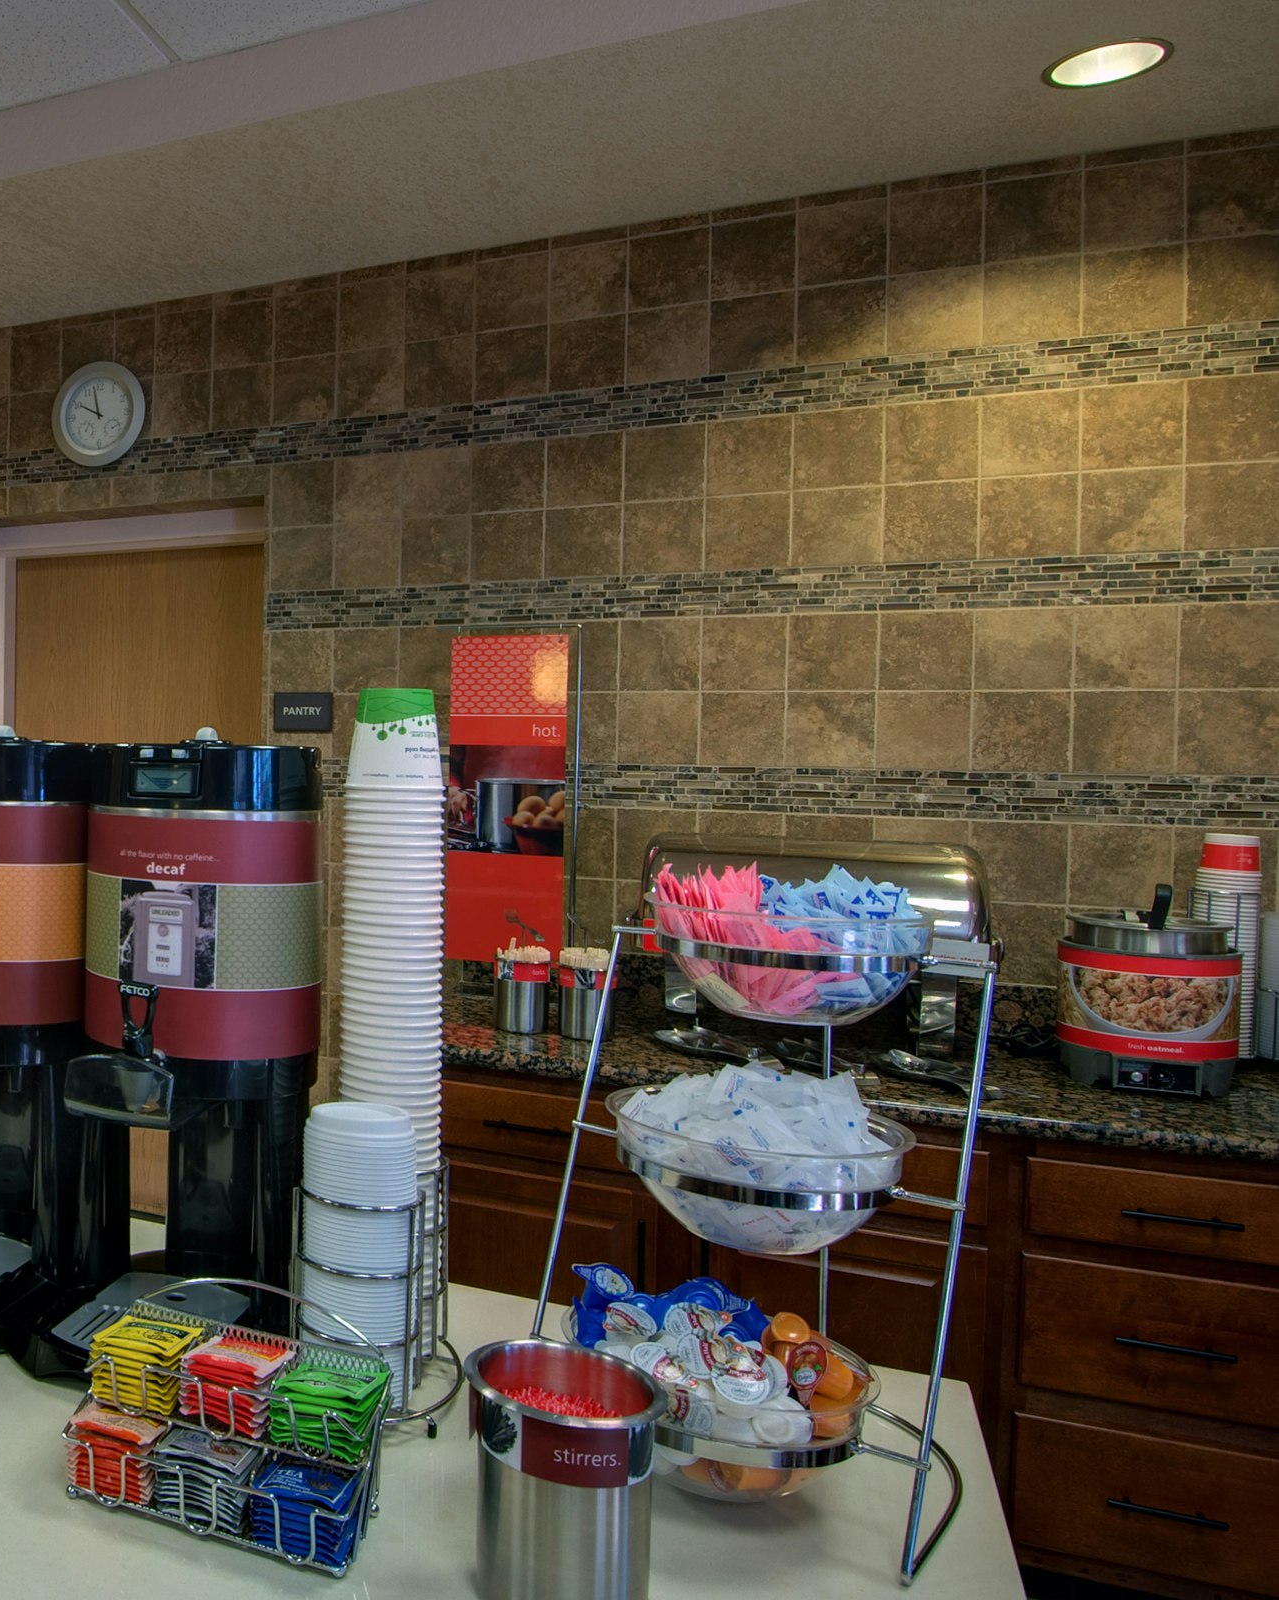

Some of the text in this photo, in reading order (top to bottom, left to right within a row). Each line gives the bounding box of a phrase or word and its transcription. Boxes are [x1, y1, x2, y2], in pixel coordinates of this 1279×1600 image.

[282, 706, 322, 716] PANTRY
[532, 723, 561, 737] hot.
[138, 850, 156, 858] flavor
[156, 852, 172, 860] with
[146, 861, 186, 876] decaf
[120, 984, 151, 997] FETCO
[1128, 1042, 1185, 1054] fresh oatmeal.
[553, 1448, 622, 1467] stirrers.
[276, 1468, 304, 1479] TEA
